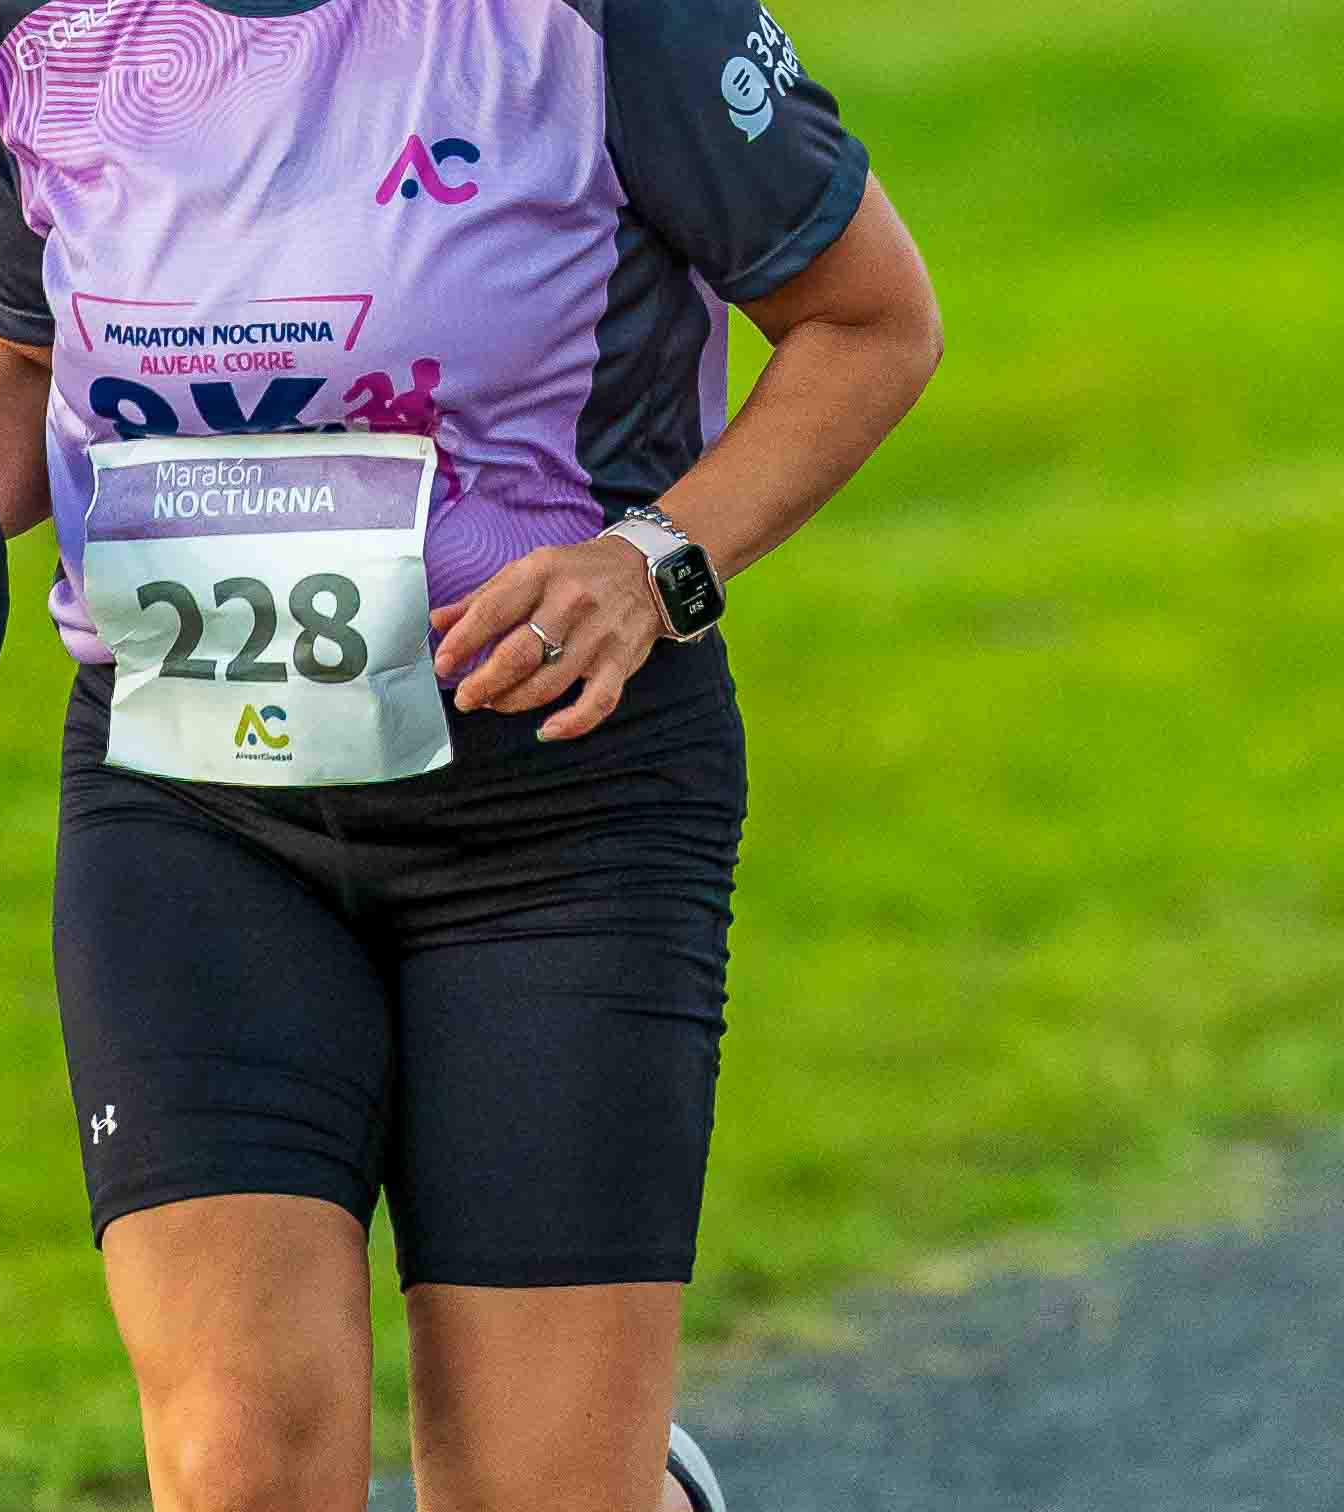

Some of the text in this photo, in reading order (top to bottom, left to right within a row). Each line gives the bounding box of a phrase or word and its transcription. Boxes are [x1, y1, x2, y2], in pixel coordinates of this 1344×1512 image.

[105, 322, 335, 348] MARATON NOCTURNA
[140, 350, 297, 376] ALVEAR CORRE
[156, 458, 262, 488] Maratón
[153, 485, 336, 519] NOCTURNA
[136, 572, 368, 684] 228
